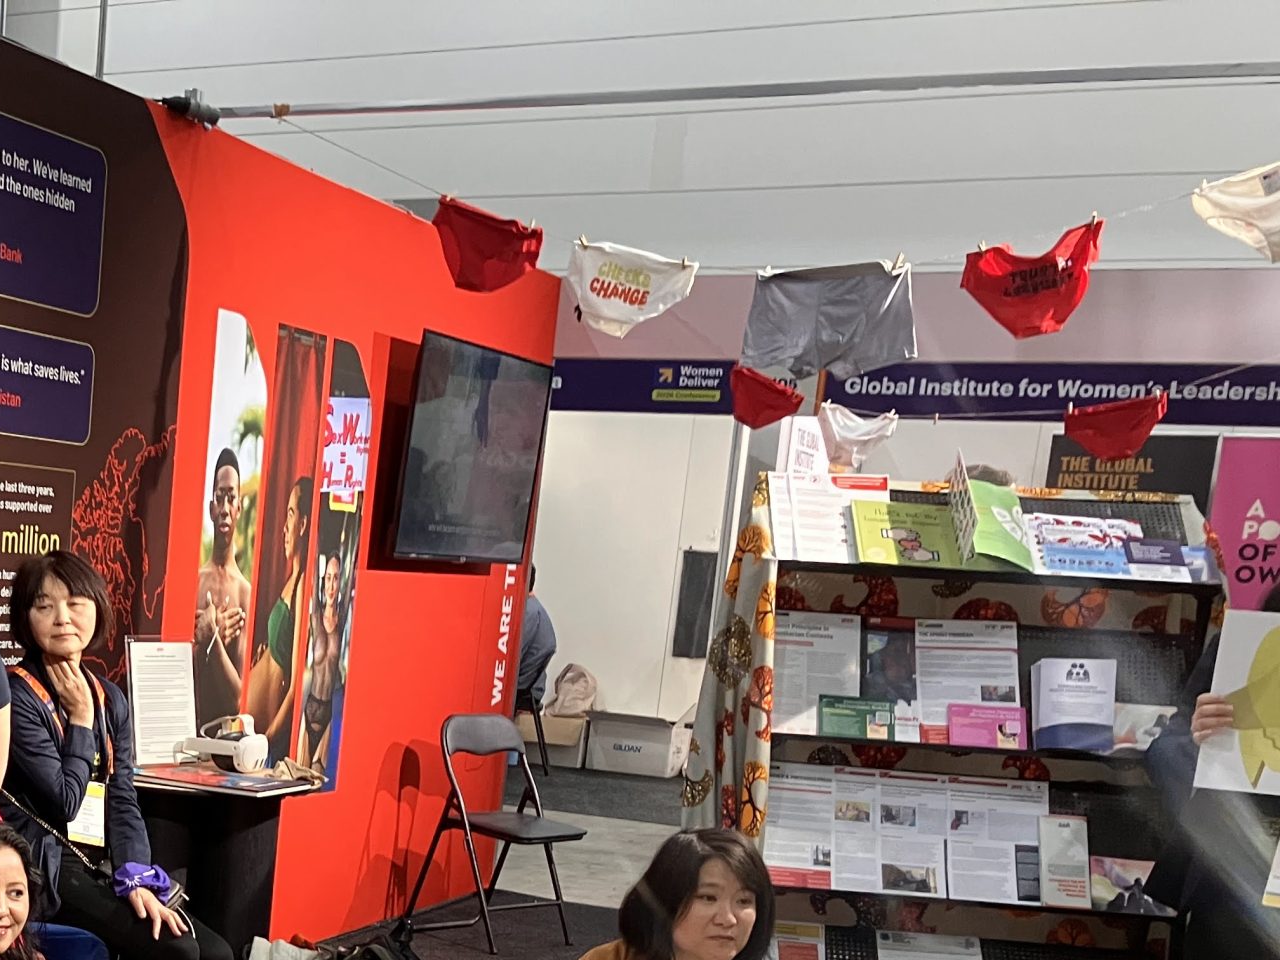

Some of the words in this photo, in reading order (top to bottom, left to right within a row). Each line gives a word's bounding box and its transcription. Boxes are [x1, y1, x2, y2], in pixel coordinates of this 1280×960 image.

[2, 150, 12, 166] to
[14, 152, 30, 172] her.
[33, 159, 58, 182] We've
[60, 168, 91, 193] learned
[0, 244, 22, 262] Bank
[590, 278, 650, 306] CHANGE
[2, 354, 9, 370] is
[11, 358, 32, 375] what
[34, 364, 58, 380] saves
[680, 366, 723, 376] Women
[679, 377, 720, 388] Deliver
[845, 376, 914, 394] Global
[919, 378, 1013, 396] Institute
[1019, 378, 1052, 397] for
[1061, 456, 1088, 472] THE
[5, 481, 17, 492] last
[18, 482, 35, 494] three
[1058, 473, 1139, 489] INSTITUTE
[5, 501, 38, 512] supported
[39, 504, 52, 513] over
[1246, 498, 1265, 518] A
[2, 524, 59, 555] million
[1238, 544, 1278, 562] OF
[498, 595, 513, 655] ARE
[491, 660, 506, 706] WE
[613, 742, 642, 754] GILDAN
